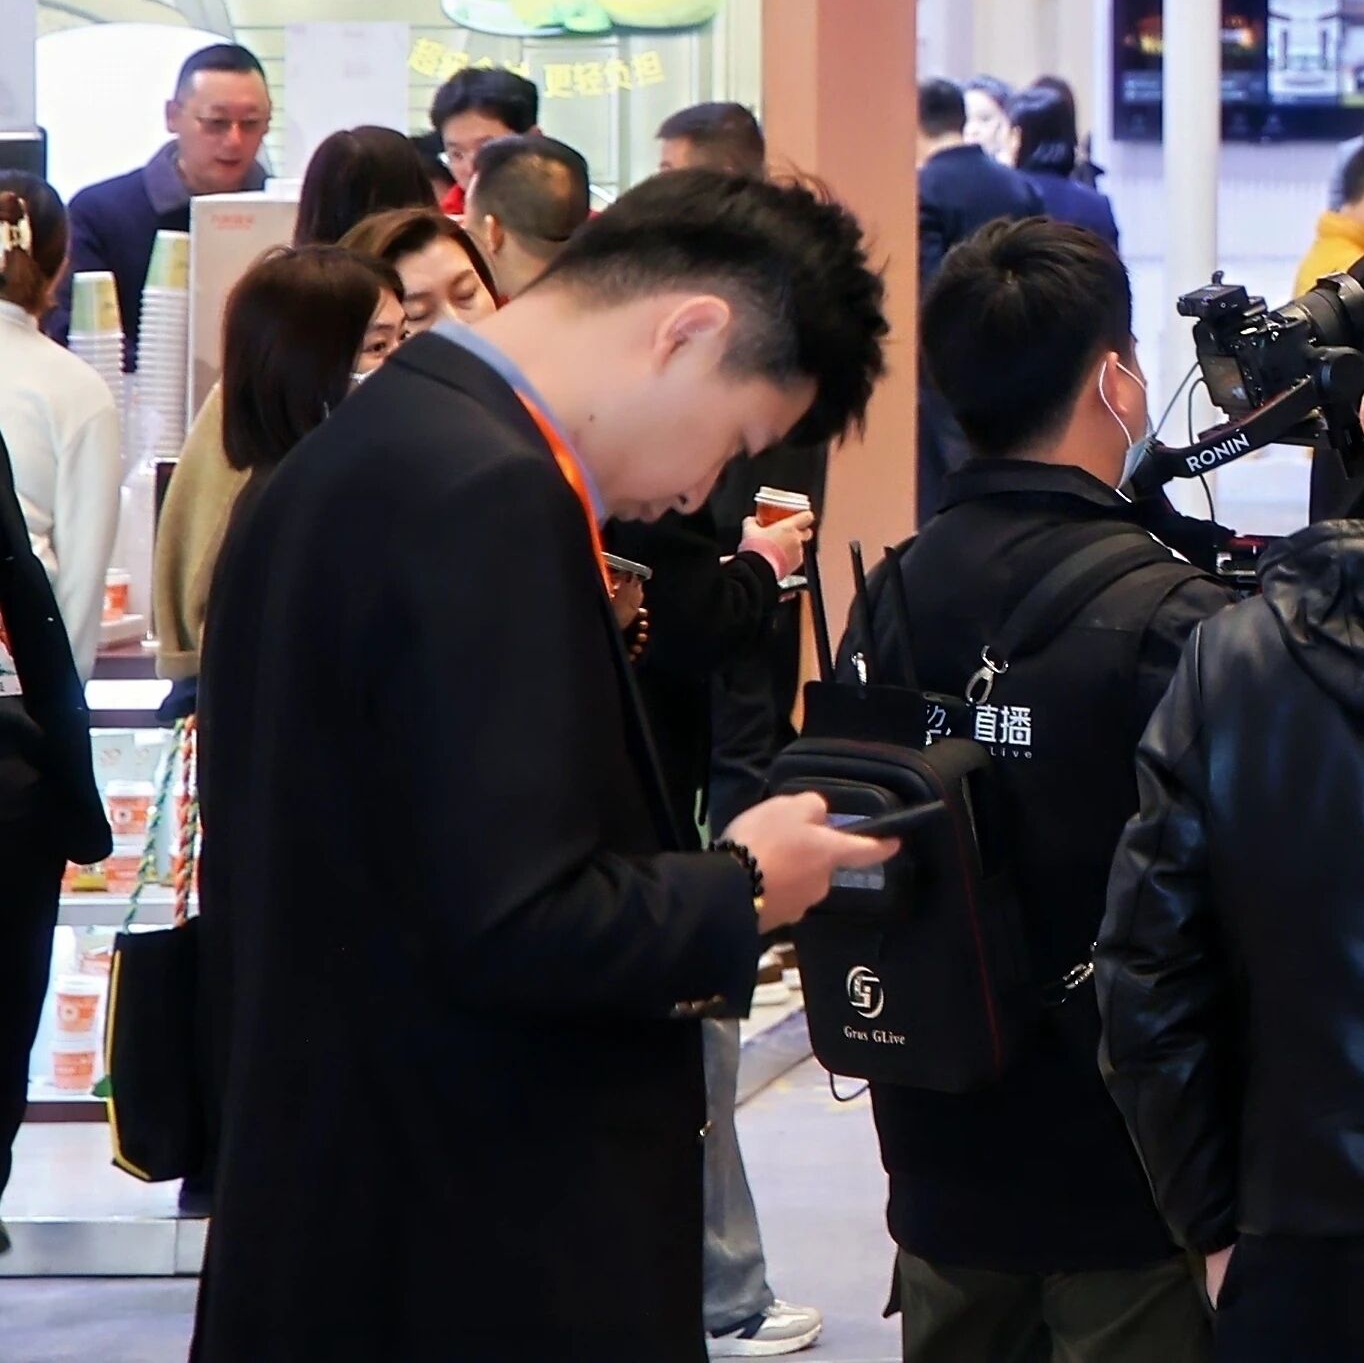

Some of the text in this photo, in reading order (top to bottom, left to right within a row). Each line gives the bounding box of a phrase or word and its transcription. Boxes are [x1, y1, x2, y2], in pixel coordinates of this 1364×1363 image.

[1185, 433, 1251, 474] RONIN
[843, 1024, 906, 1046] Grus GLive
